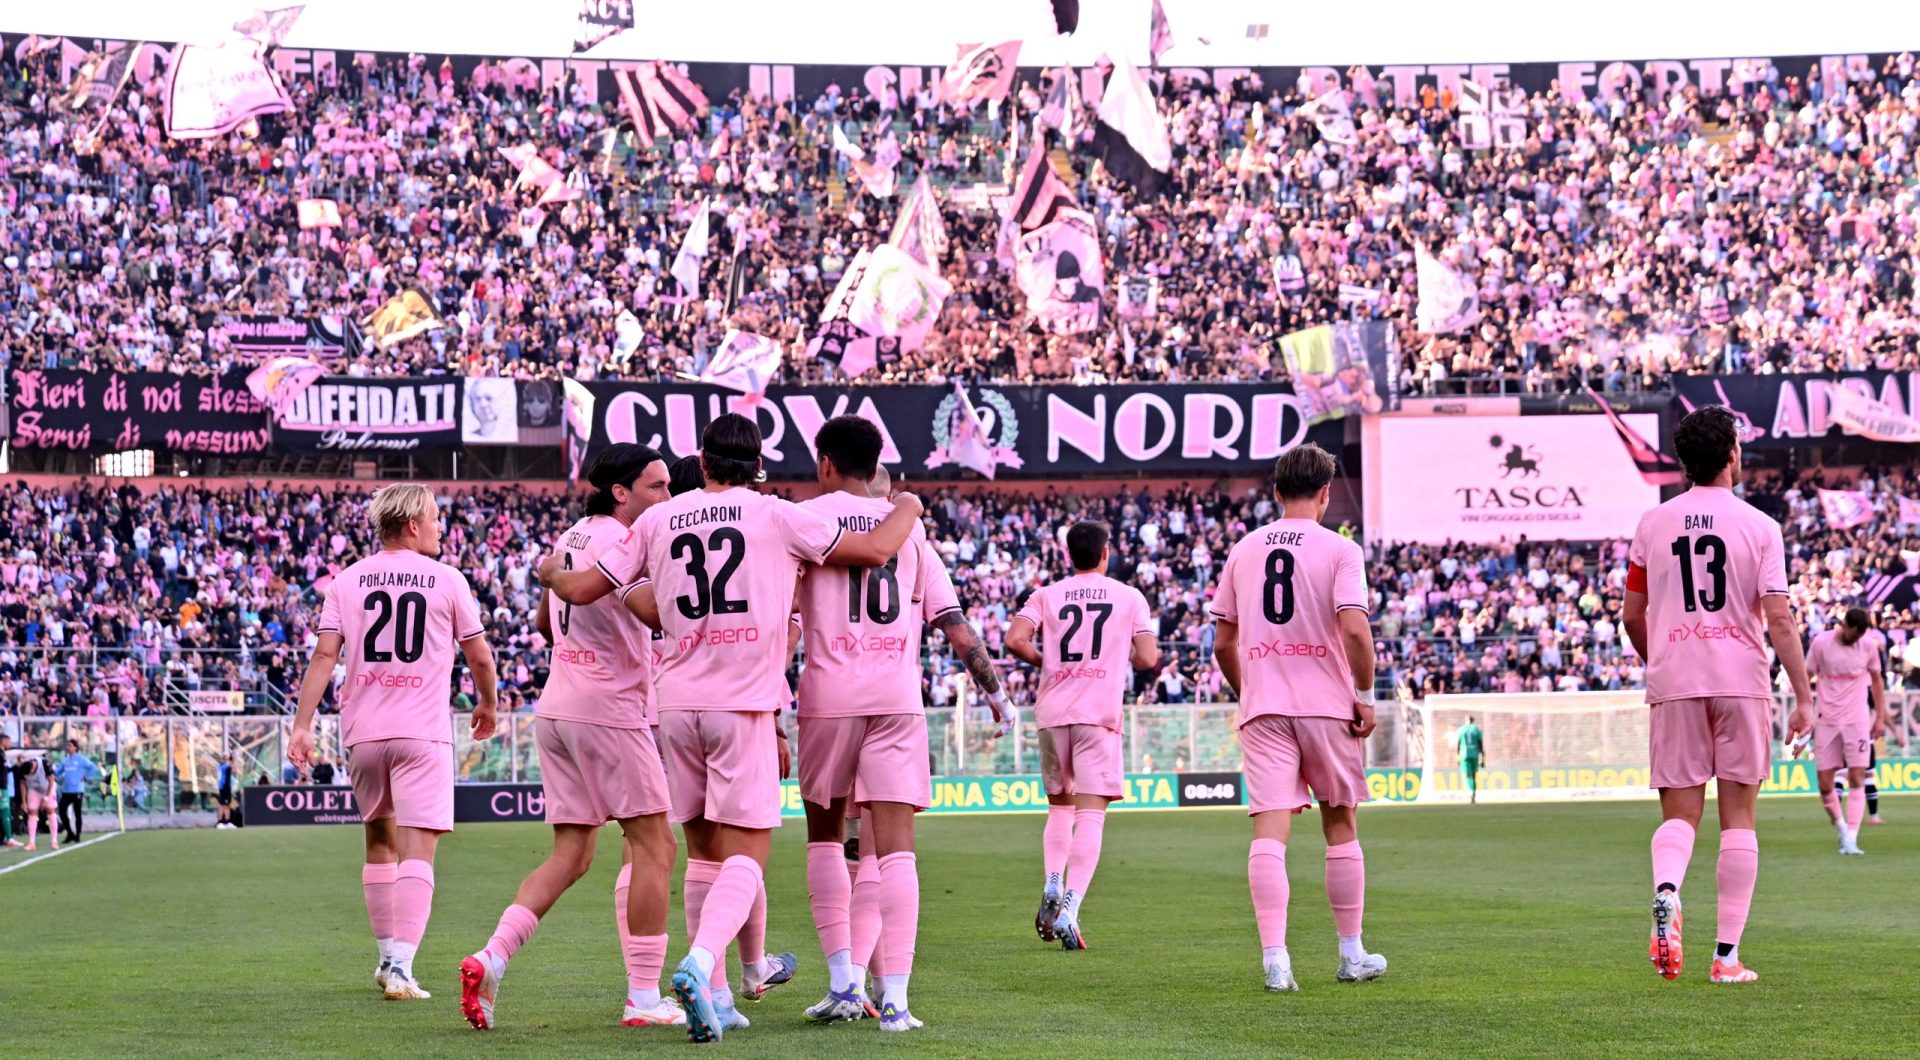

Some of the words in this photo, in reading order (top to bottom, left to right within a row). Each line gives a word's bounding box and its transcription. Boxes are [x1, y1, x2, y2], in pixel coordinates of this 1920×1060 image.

[103, 374, 128, 412] di
[199, 372, 267, 414] stess
[12, 411, 90, 448] Servi
[115, 417, 140, 449] di
[316, 430, 421, 450] Palermo
[1047, 392, 1310, 462] NORD
[1455, 486, 1584, 509] TASCA
[669, 506, 742, 531] CECCARONI
[1684, 514, 1714, 530] BANI
[1265, 531, 1305, 547] SEGRE
[359, 571, 436, 589] POHJANPALO
[670, 526, 749, 620] 32
[1263, 548, 1294, 625] 8
[1671, 534, 1727, 613] 13
[1065, 588, 1107, 601] PIEROZZI
[363, 590, 427, 663] 20
[1058, 603, 1113, 663] 27
[991, 780, 1049, 806] SOL
